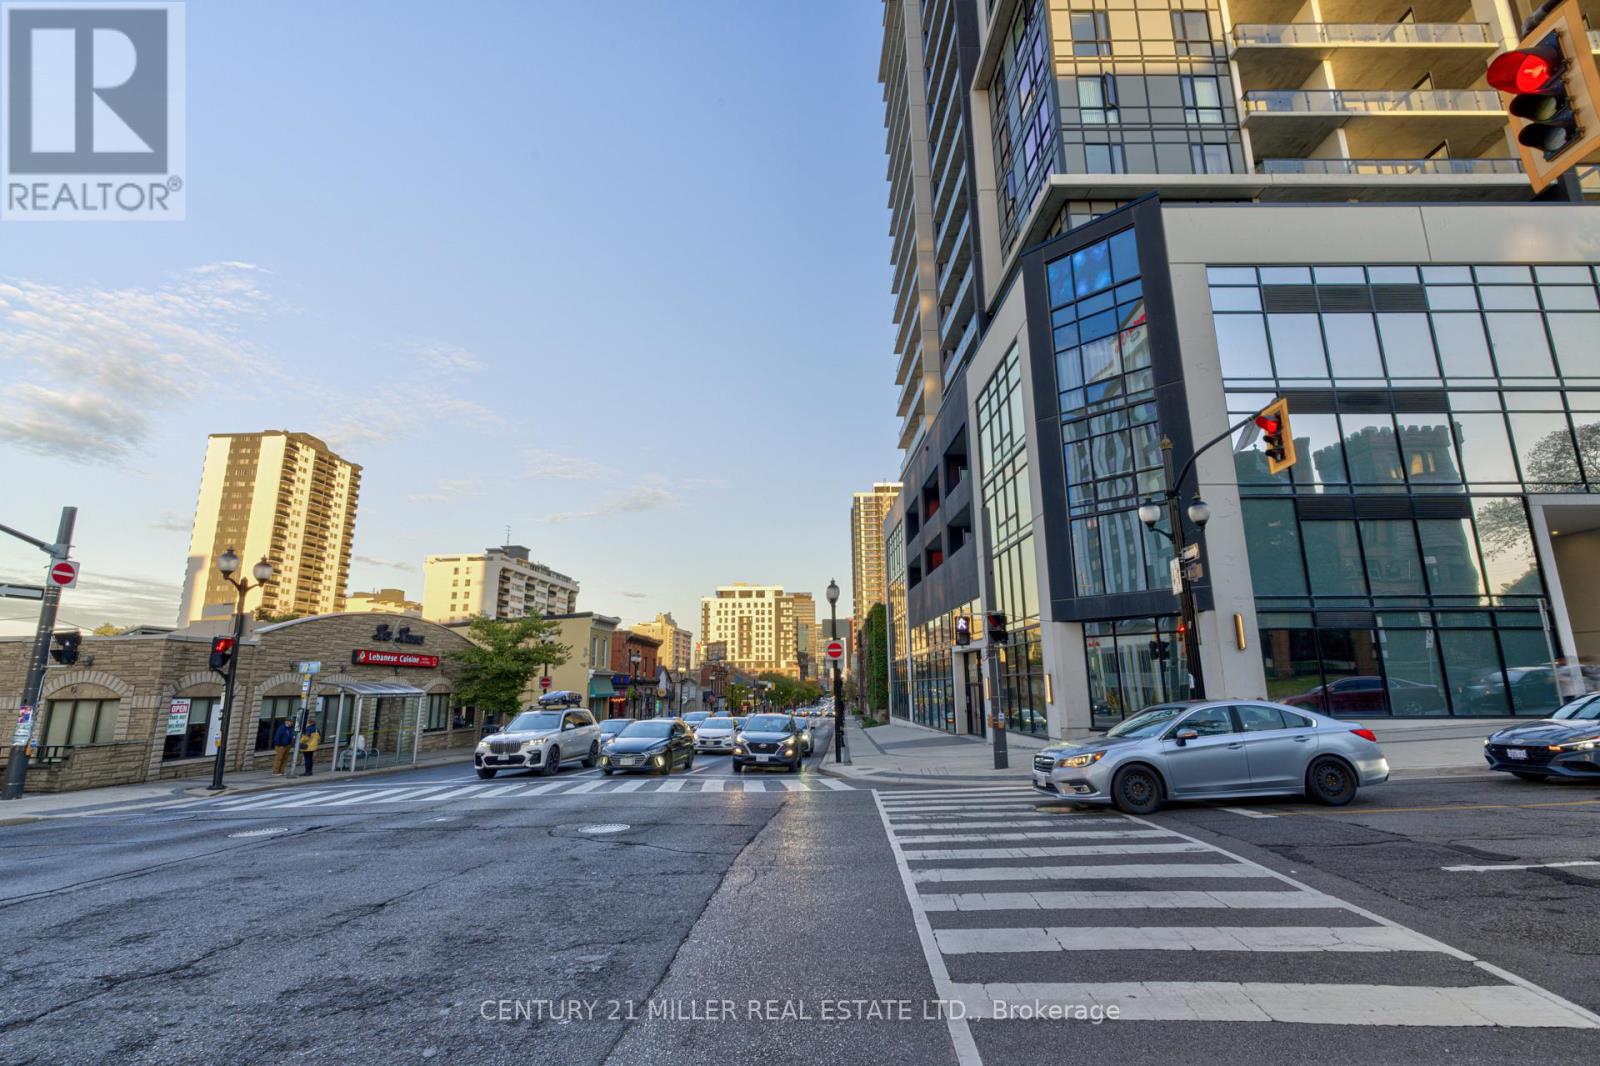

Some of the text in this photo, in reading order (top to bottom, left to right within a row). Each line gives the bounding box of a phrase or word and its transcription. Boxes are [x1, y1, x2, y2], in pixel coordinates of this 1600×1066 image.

[368, 652, 398, 662] Lebanese
[399, 655, 420, 664] Cuisine
[171, 705, 188, 713] OPEN
